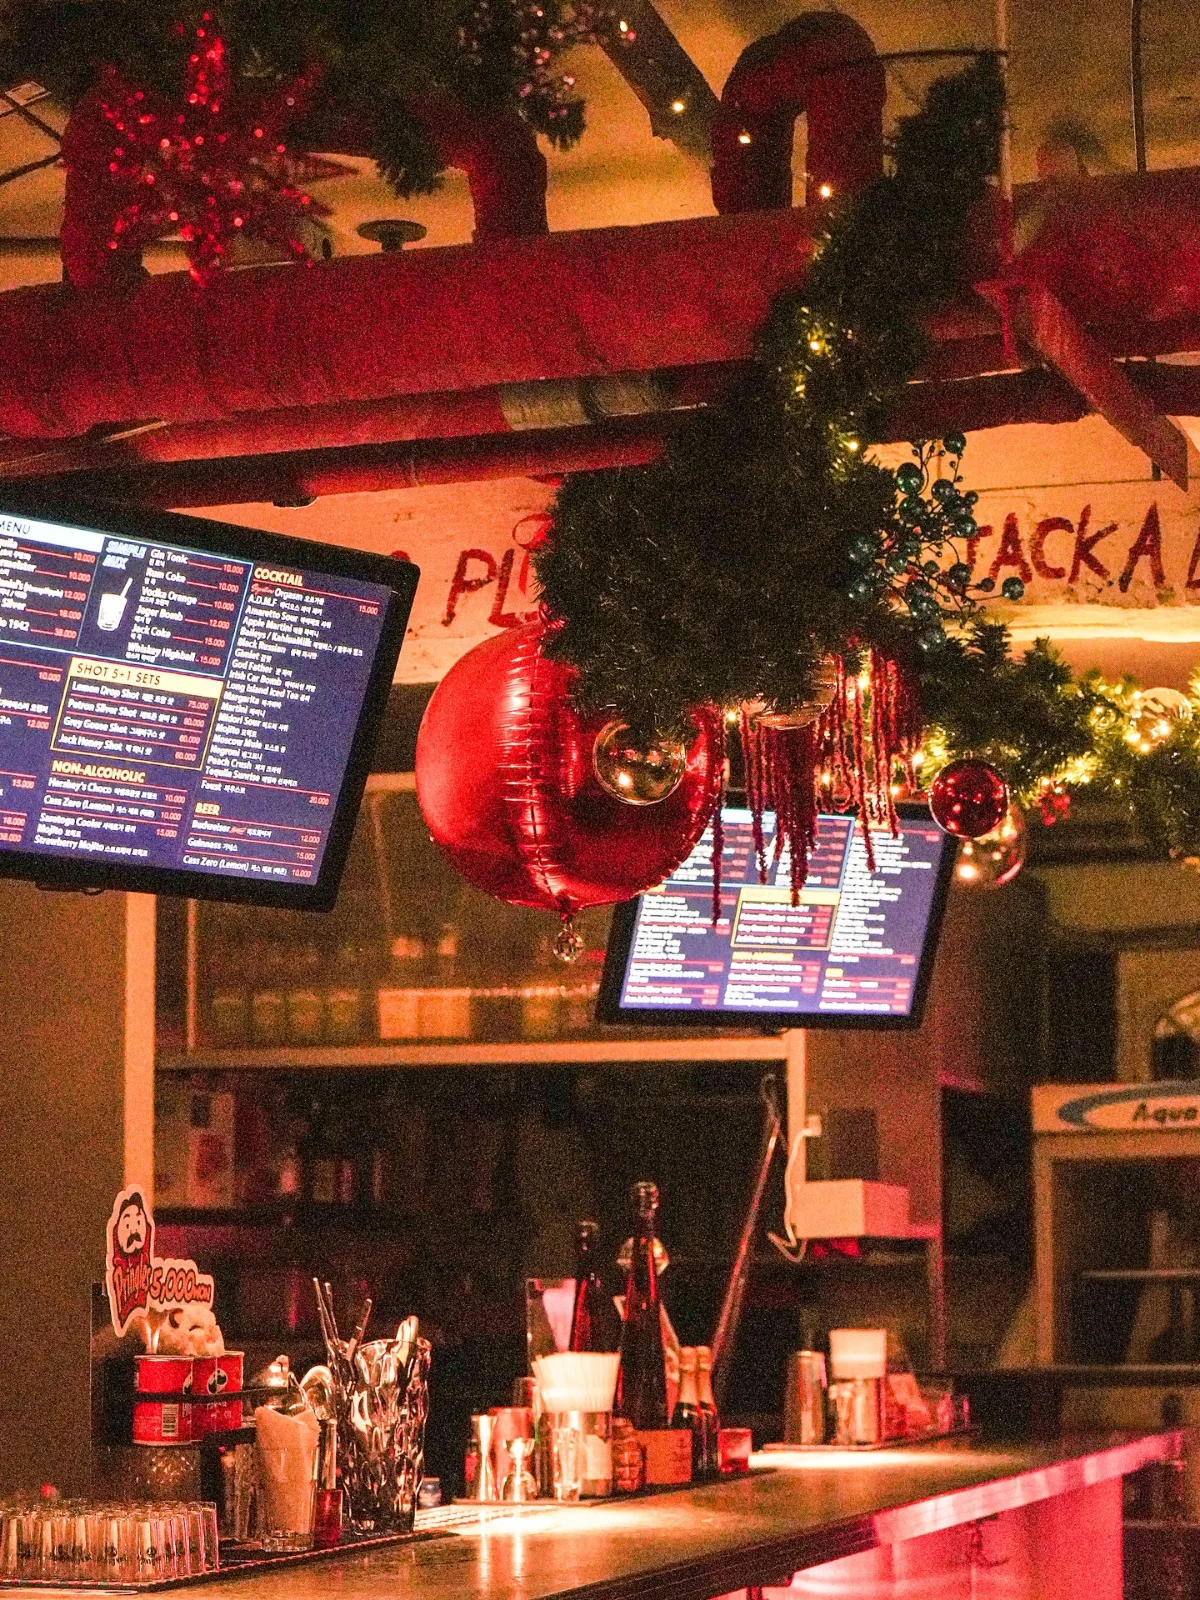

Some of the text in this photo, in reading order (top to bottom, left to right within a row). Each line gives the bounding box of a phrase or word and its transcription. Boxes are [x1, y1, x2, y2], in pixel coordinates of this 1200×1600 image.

[151, 549, 165, 559] Gin
[167, 552, 188, 564] Tonic
[165, 572, 186, 583] Coke
[254, 568, 303, 586] COCKTAIL
[142, 586, 167, 599] Vodka
[166, 591, 197, 605] Orange
[274, 588, 303, 601] Orgasm
[243, 616, 265, 628] Apple
[266, 620, 293, 632] Martini
[281, 612, 298, 622] Sour
[151, 627, 171, 638] Coke
[232, 659, 273, 673] God Father
[76, 663, 162, 686] SHOT 5+1 SETS
[229, 670, 282, 686] Irish Car Bomb
[72, 681, 100, 693] Lemon
[100, 685, 120, 698] Drop
[121, 689, 140, 700] Shot
[226, 680, 246, 693] Long
[246, 684, 269, 695] Island
[287, 690, 299, 700] Tea
[118, 707, 137, 717] Shot
[64, 716, 83, 729] Grey
[109, 723, 128, 734] Shot
[215, 723, 240, 735] Mojito
[243, 717, 261, 727] Sour
[58, 734, 77, 745] Jack
[78, 736, 104, 750] Honey
[104, 740, 123, 751] Shot
[212, 734, 244, 746] Moscow
[244, 738, 262, 749] Mule
[207, 755, 230, 766] Peach
[52, 760, 145, 783] NON-ALCOHOLIC
[195, 802, 220, 815] BEER
[192, 820, 230, 832] Budweiser
[188, 838, 222, 849] Guinness
[297, 852, 316, 860] 15.000
[183, 855, 200, 864] Cass
[200, 857, 218, 867] Zero
[219, 859, 249, 872] (Lemon)
[292, 869, 311, 877] 10.000
